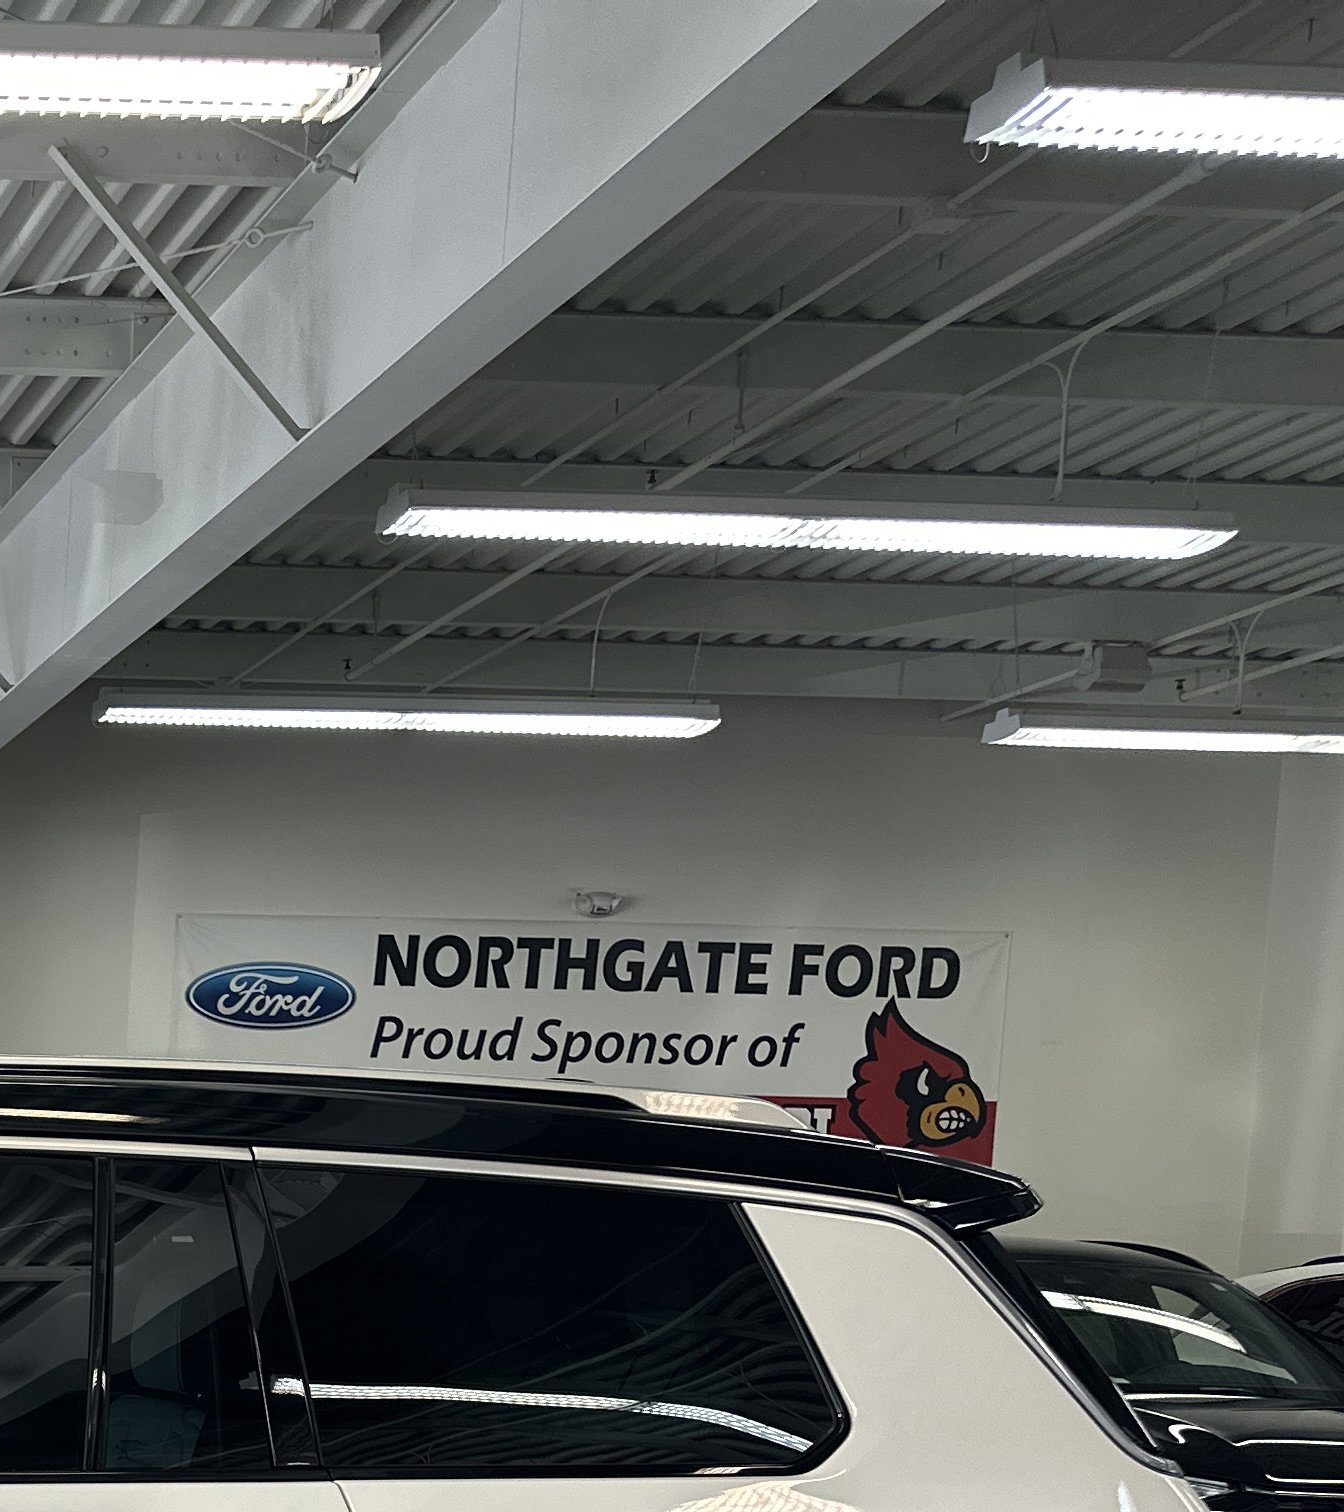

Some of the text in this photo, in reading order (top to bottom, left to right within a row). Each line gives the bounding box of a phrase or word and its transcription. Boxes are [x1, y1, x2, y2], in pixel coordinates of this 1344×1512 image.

[217, 971, 324, 1018] Ford
[373, 933, 961, 998] NORTHGATE FORD
[369, 1015, 806, 1075] Proud Sponsor of
